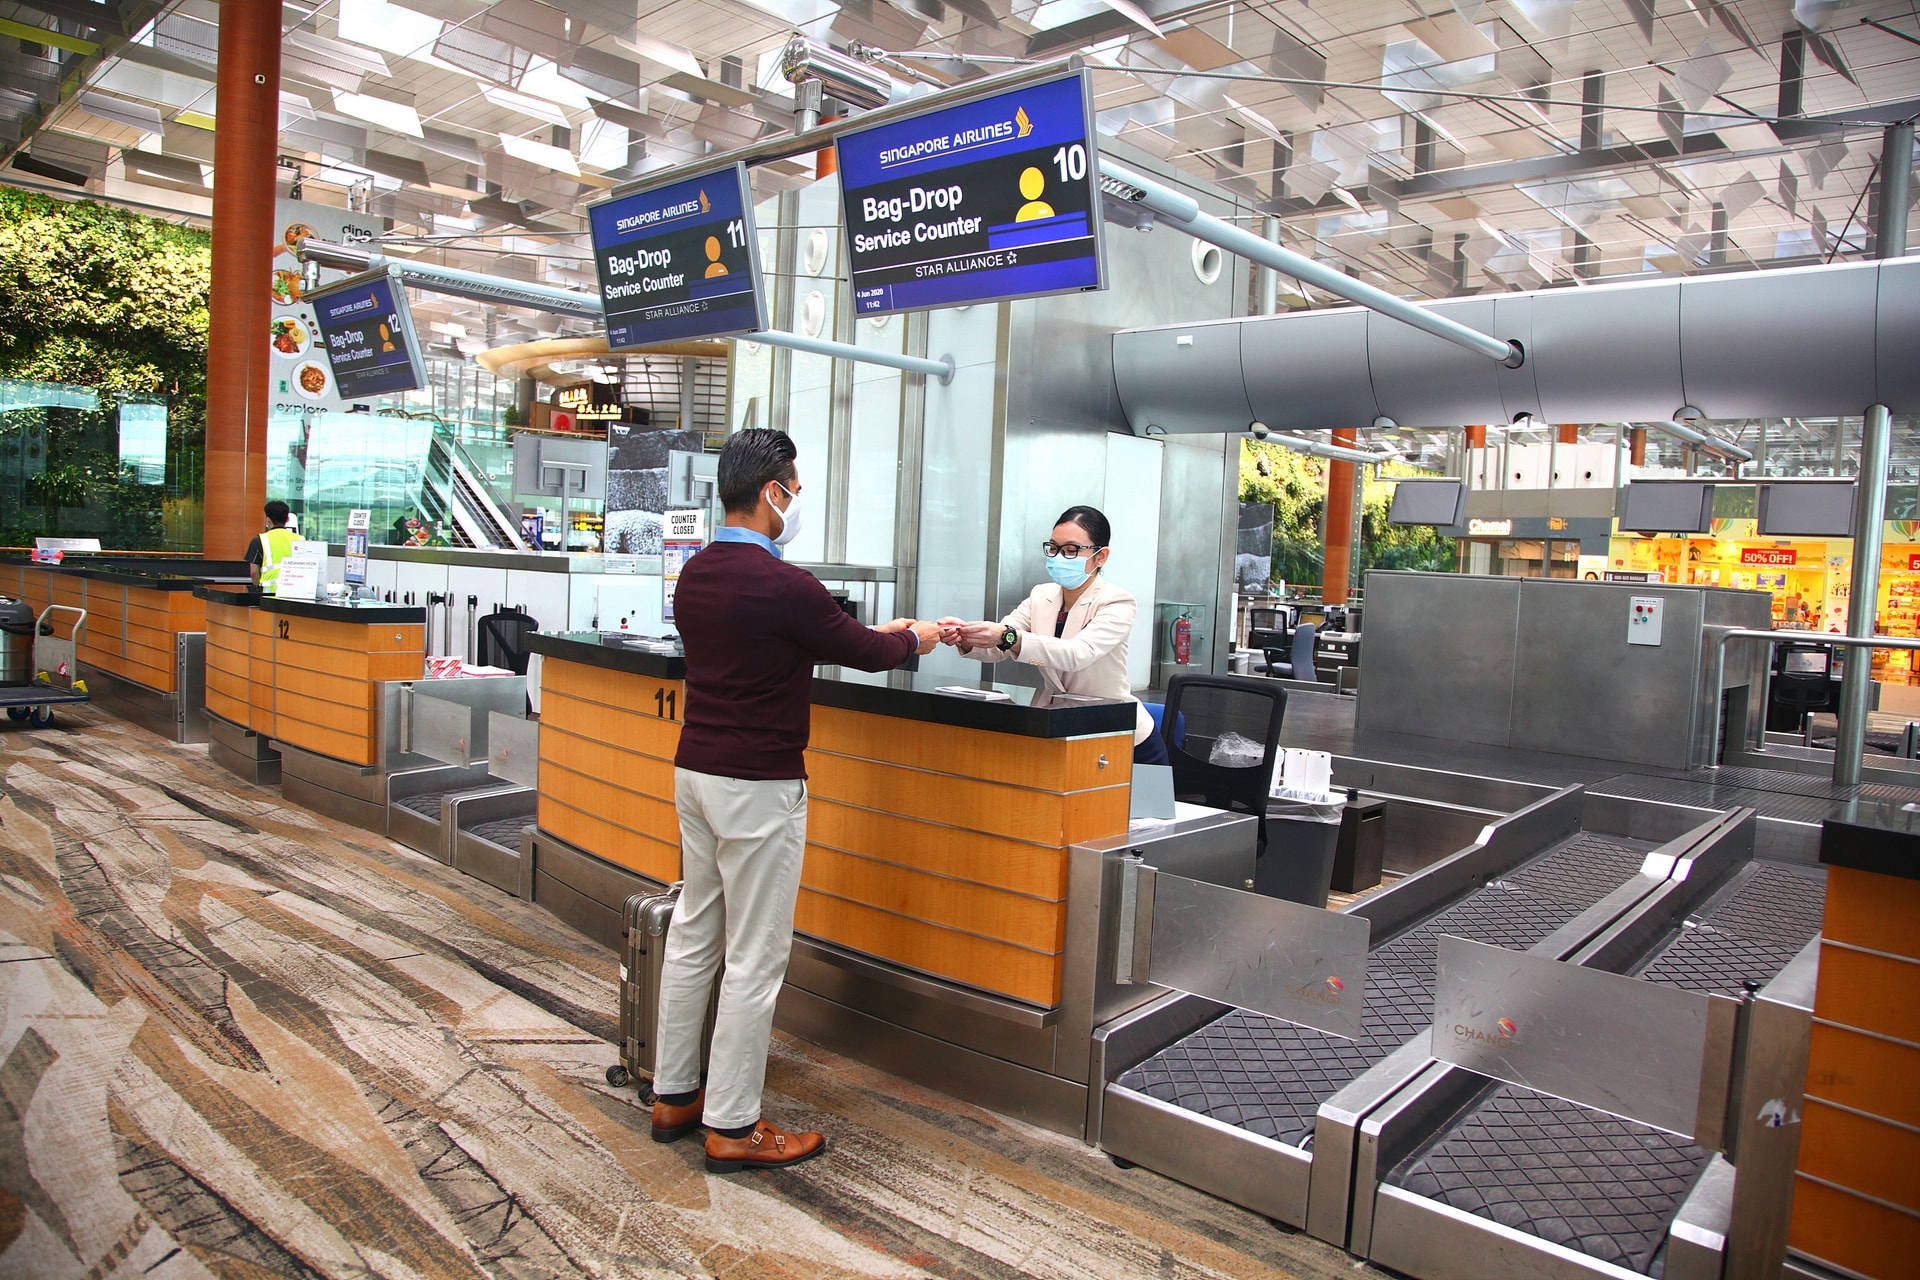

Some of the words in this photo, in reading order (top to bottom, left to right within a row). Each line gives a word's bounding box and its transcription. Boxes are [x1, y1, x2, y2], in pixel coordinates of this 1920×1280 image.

[879, 136, 950, 165] SINGAPORE
[953, 120, 1013, 148] AIRLINES
[1053, 143, 1087, 184] 10
[862, 184, 963, 223] Bag-Drop
[616, 210, 661, 231] SINGAPORE
[662, 200, 699, 219] AIRLINES
[726, 219, 746, 249] 11
[854, 228, 911, 253] Service
[914, 215, 982, 243] Counter
[608, 248, 671, 277] Bag-Drop
[915, 265, 944, 278] STAR
[946, 254, 1004, 273] ALLIANCE
[605, 281, 641, 300] Service
[642, 273, 685, 292] Counter
[871, 288, 884, 296] 2020
[329, 304, 353, 317] SINGAPORE
[354, 299, 373, 311] AIRLINES
[645, 310, 663, 320] STAR
[664, 302, 700, 317] ALLIANCE
[866, 300, 880, 309] 11:42
[388, 313, 402, 333] 12
[329, 330, 364, 349] Bag-Drop
[331, 352, 352, 364] Service
[350, 347, 373, 360] Counter
[276, 403, 328, 416] explore
[671, 514, 697, 524] COUNTER
[672, 526, 694, 534] CLOSED
[1744, 553, 1768, 563] 50%
[1768, 554, 1793, 564] OFF!
[278, 619, 290, 640] 12
[654, 688, 676, 720] 11
